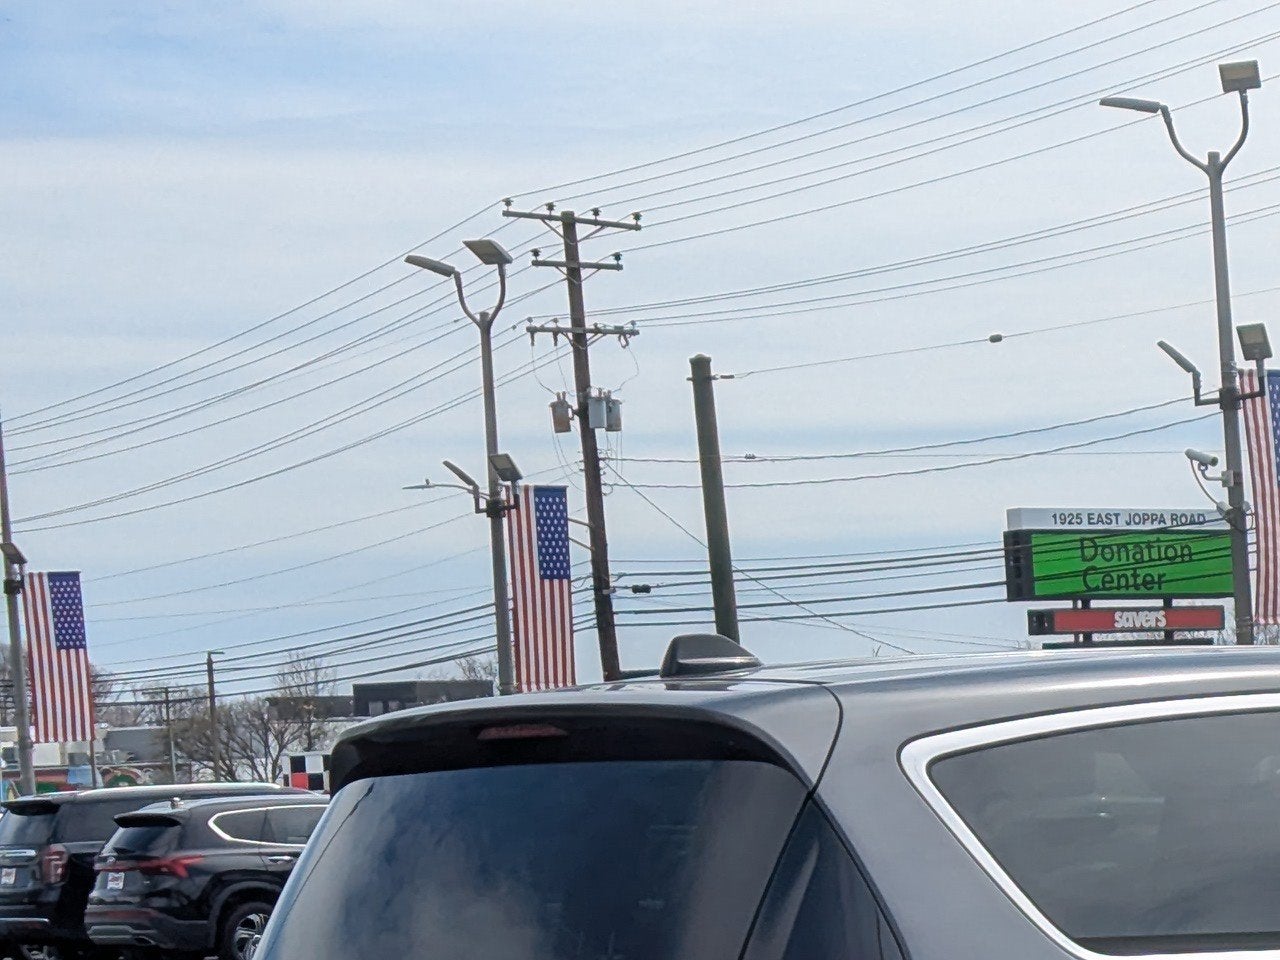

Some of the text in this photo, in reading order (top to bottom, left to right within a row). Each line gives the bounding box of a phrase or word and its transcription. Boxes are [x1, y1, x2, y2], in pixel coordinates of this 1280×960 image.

[1052, 512, 1207, 526] 1925 EAST JOPPA ROAD
[1080, 537, 1193, 562] Donation
[1082, 565, 1167, 591] Center
